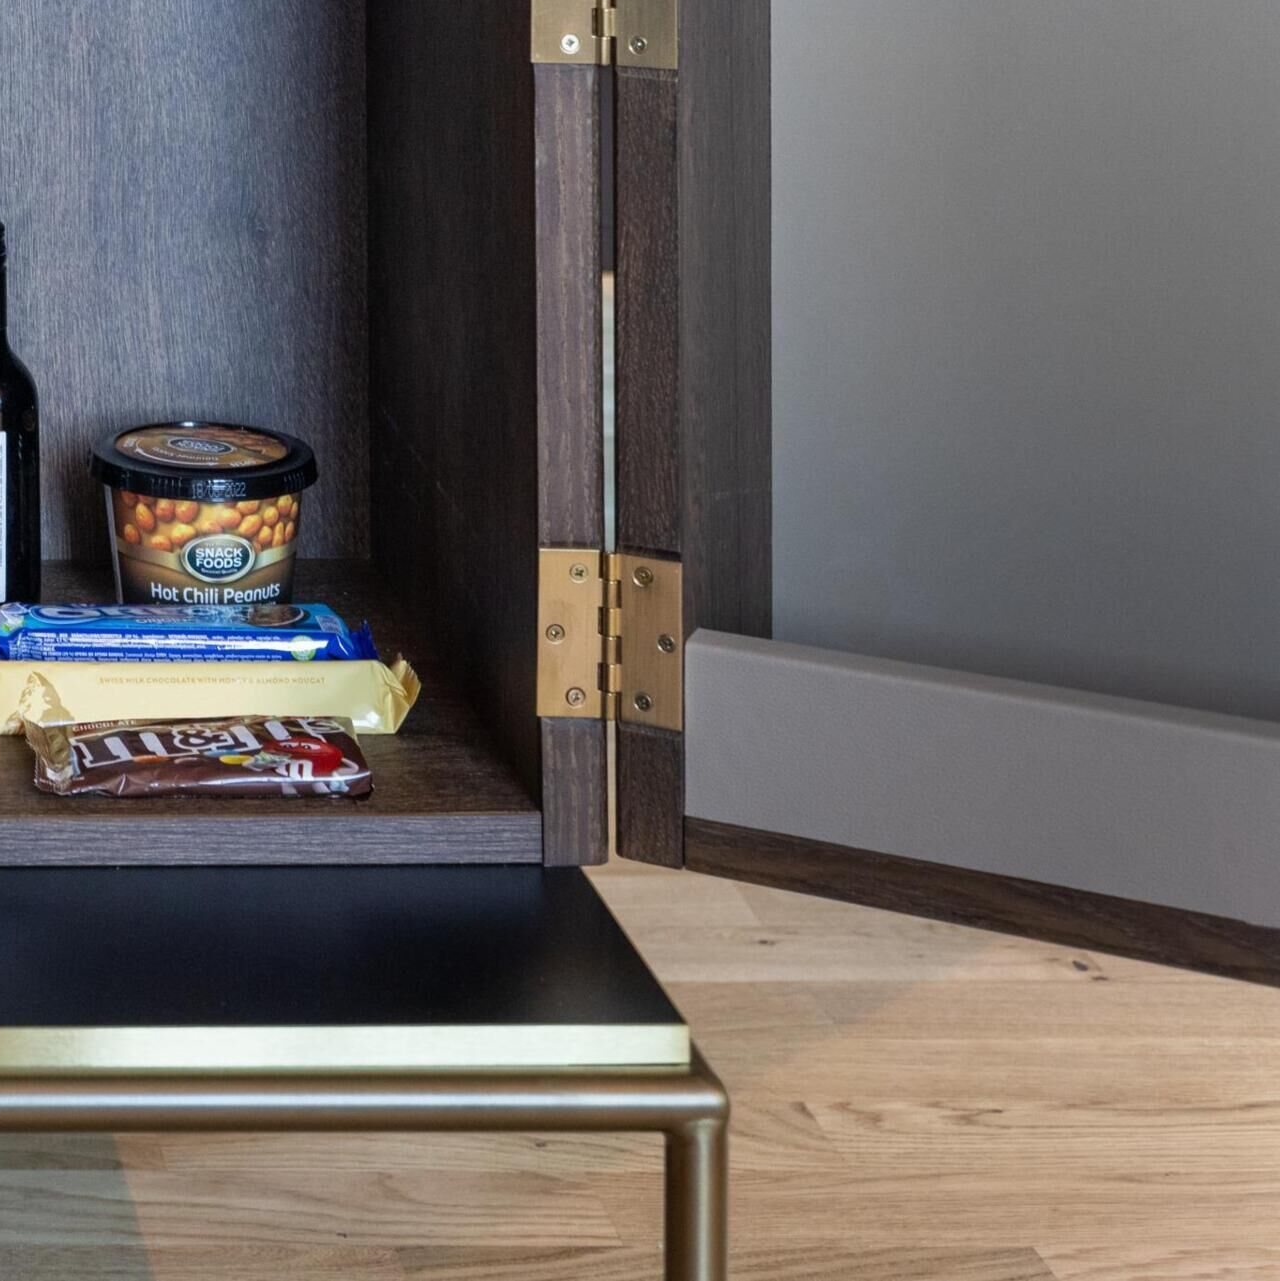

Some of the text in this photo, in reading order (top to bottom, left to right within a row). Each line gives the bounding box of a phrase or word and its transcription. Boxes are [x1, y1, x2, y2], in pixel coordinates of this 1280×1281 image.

[195, 547, 243, 558] SNACK
[195, 557, 242, 569] FOODS
[150, 581, 281, 605] Hot Chili Peanuts
[146, 677, 195, 685] CHOCOLATE
[292, 677, 326, 685] NOUGAT
[72, 718, 137, 732] CHOCOLATE
